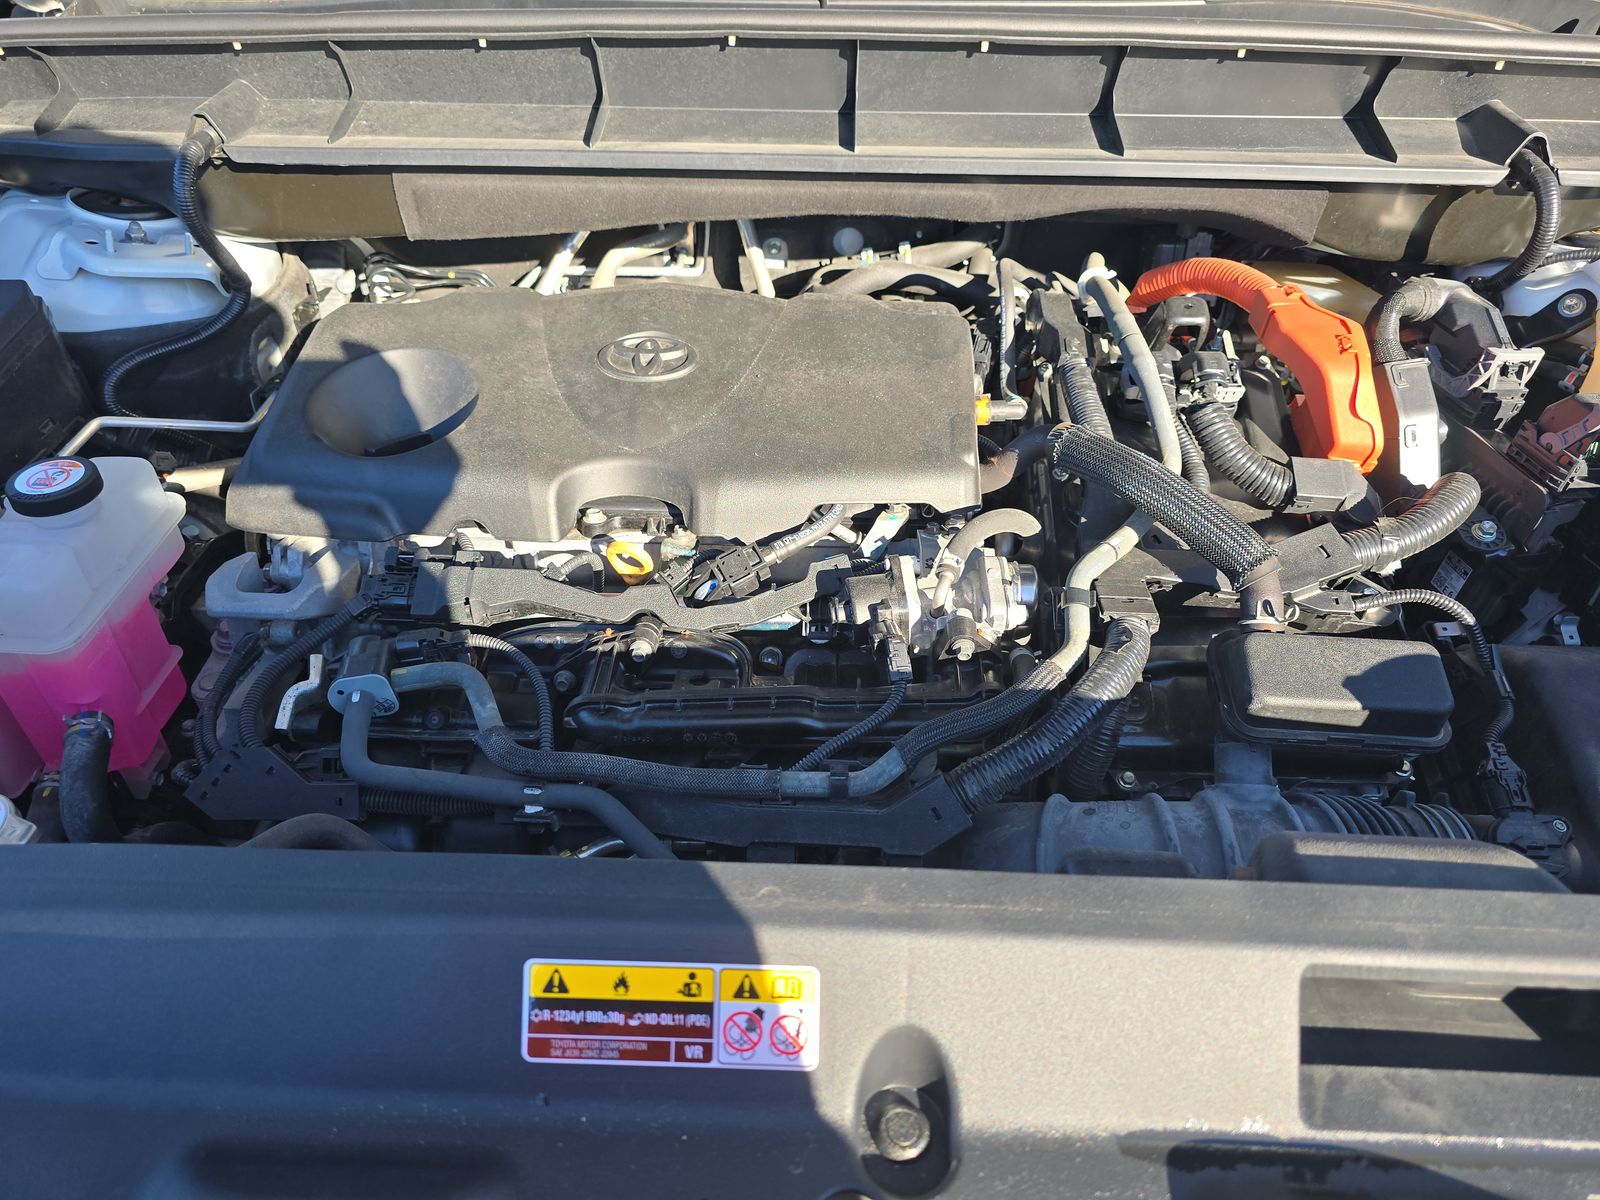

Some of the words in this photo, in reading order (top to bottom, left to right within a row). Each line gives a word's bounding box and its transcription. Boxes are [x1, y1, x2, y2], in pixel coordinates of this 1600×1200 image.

[550, 1039, 576, 1048] TOYOTA
[577, 1040, 601, 1049] MOTOR
[602, 1040, 648, 1051] CORPORATION
[684, 1045, 704, 1059] VR
